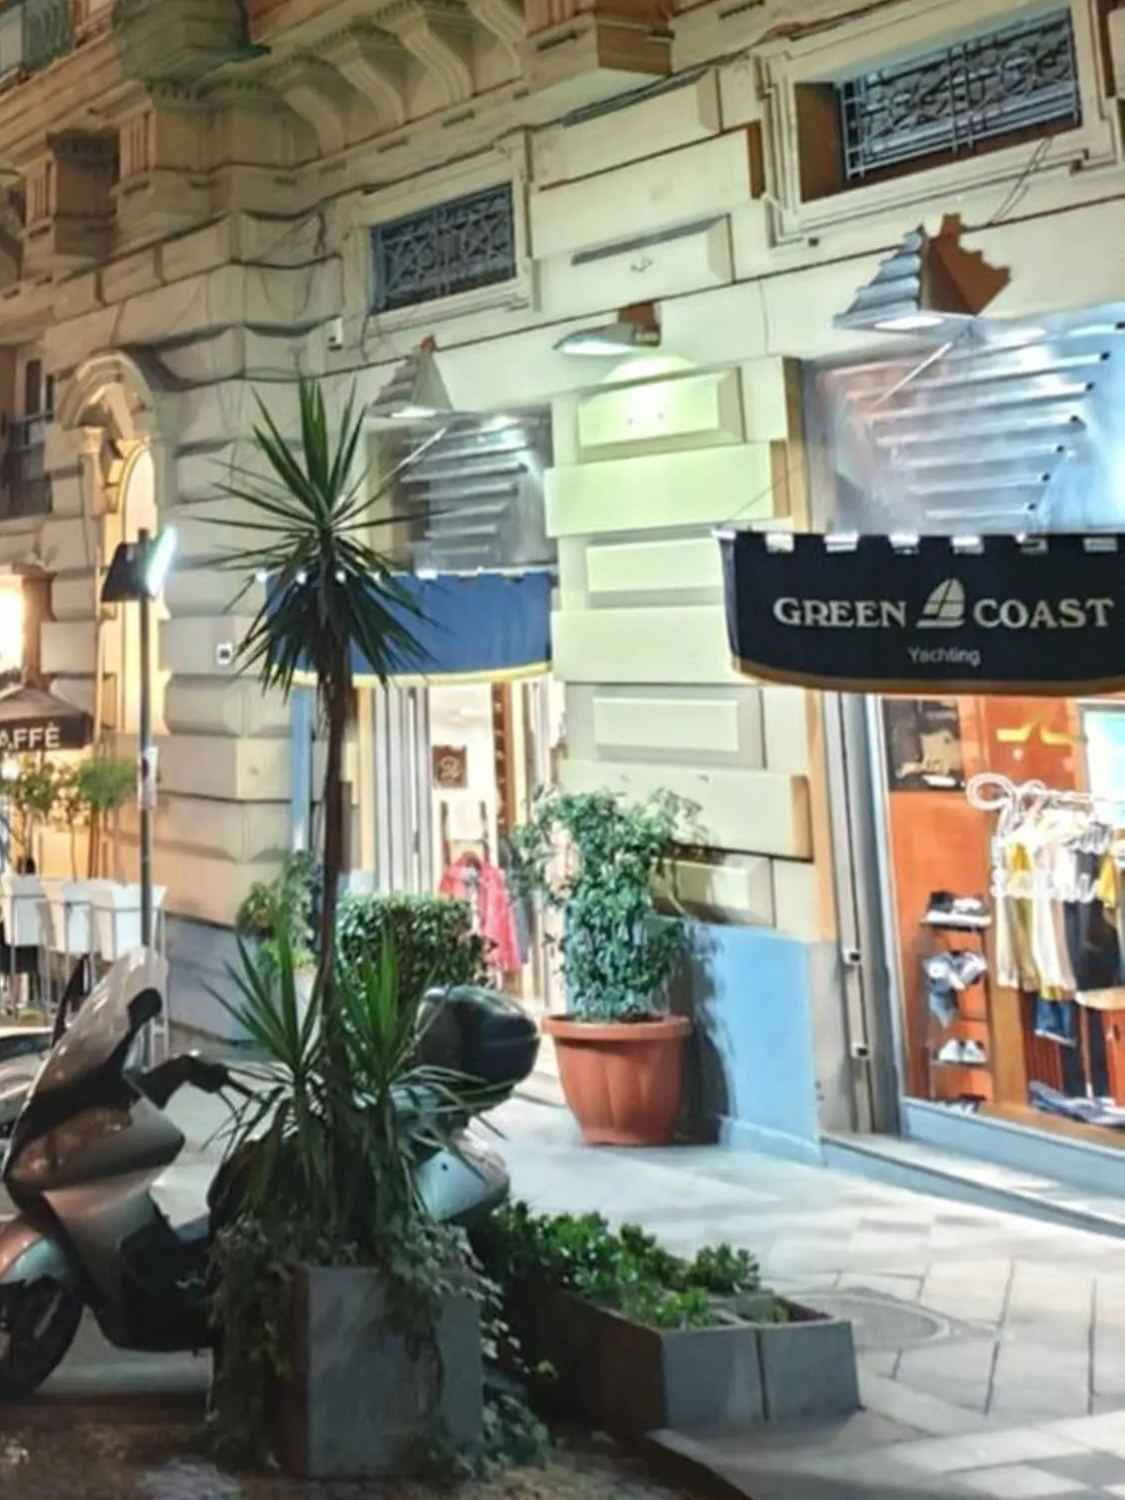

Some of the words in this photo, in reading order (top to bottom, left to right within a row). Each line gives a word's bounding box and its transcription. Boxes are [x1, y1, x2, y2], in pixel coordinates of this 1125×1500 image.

[773, 596, 907, 627] GREEN
[974, 598, 1114, 628] COAST
[907, 647, 980, 666] Yachting
